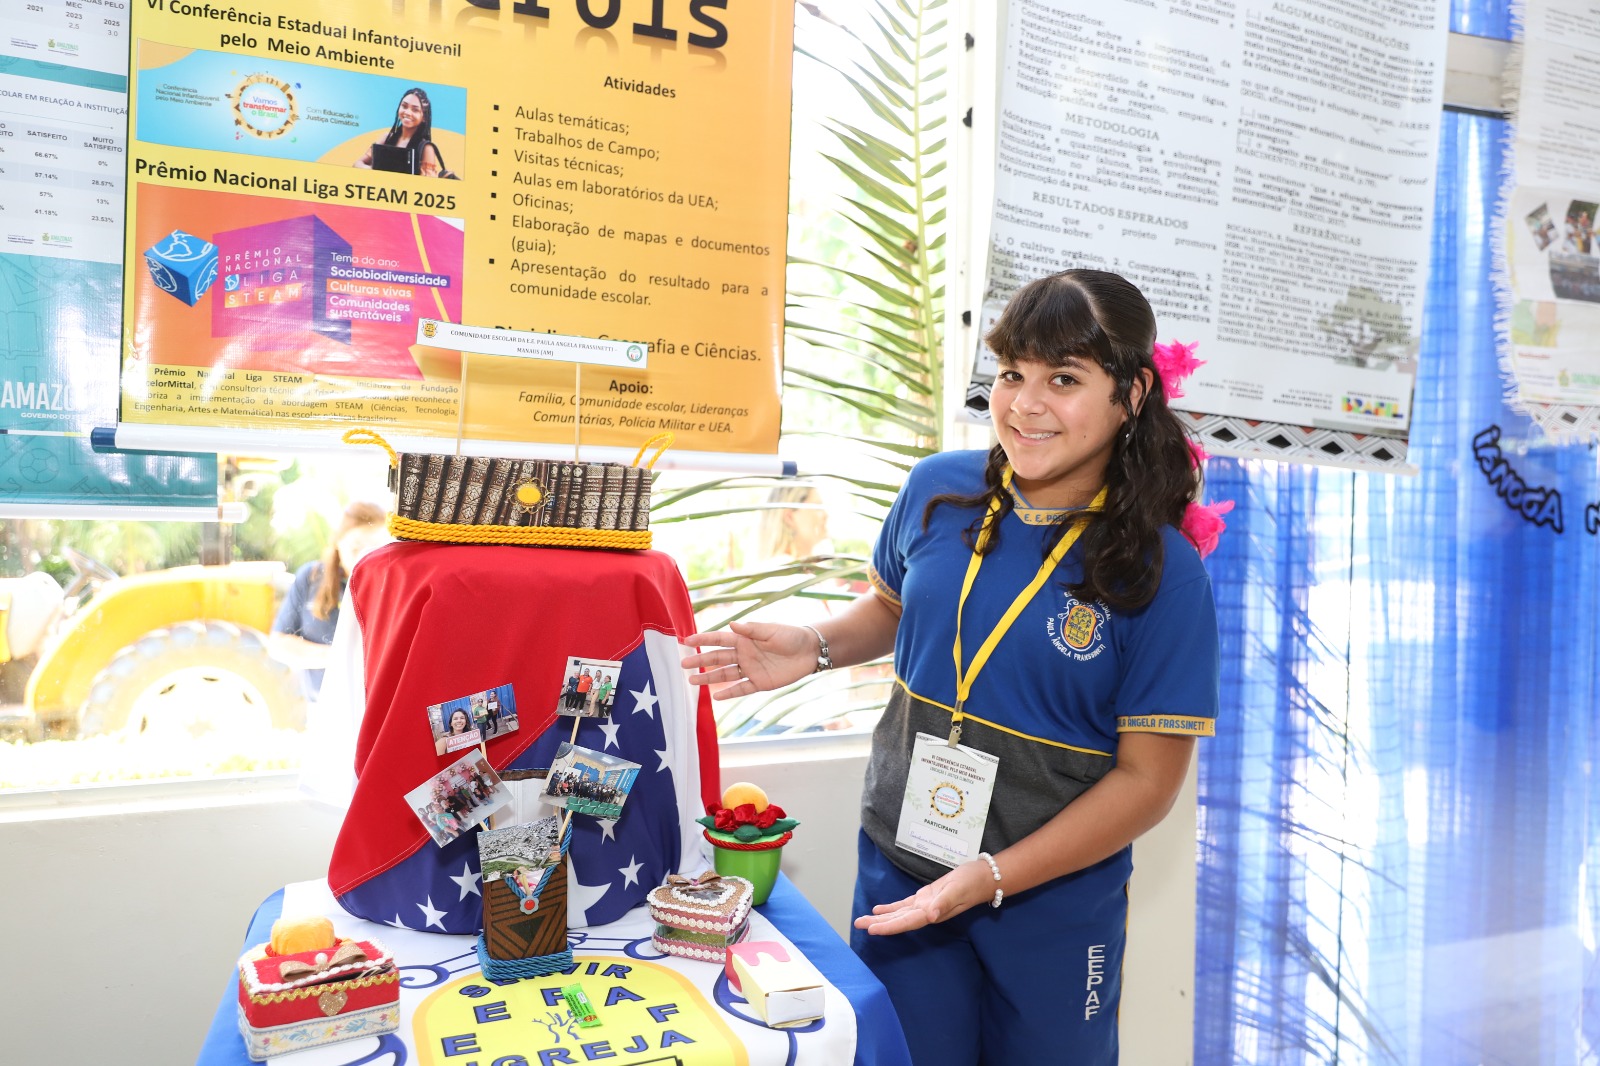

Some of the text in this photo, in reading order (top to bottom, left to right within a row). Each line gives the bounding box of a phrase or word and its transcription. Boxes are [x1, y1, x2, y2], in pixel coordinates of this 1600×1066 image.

[27, 4, 44, 12] 2021
[66, 1, 82, 9] MEC
[104, 0, 124, 9] PELO
[66, 12, 82, 20] 2023
[104, 19, 120, 27] 2025
[170, 0, 271, 27] Conferência
[278, 15, 347, 38] Estadual
[352, 28, 461, 57] Infantojuvenil
[220, 33, 395, 69] pelo Meio Ambiente
[604, 75, 676, 98] Atividades
[25, 93, 38, 101] EM
[39, 95, 75, 107] RELAÇÃO
[242, 102, 287, 113] transformar
[253, 96, 278, 105] Vamos
[323, 108, 354, 120] Educação
[330, 117, 359, 127] Climática
[515, 105, 630, 136] Aulas temáticas;
[1065, 112, 1160, 142] METODOLOGIA
[27, 130, 68, 141] SATISFEITO
[92, 136, 114, 144] MUITO
[83, 142, 122, 153] SATISFEITO
[515, 127, 660, 162] Trabalhos de Campo;
[514, 149, 624, 178] Visitas técnicas;
[135, 158, 456, 210] Prêmio Nacional Liga STEAM 2025
[513, 171, 719, 211] Aulas em laboratórios da UEA;
[513, 193, 573, 214] Oficinas;
[1032, 191, 1189, 231] RESULTADOS ESPERADOS
[512, 215, 770, 256] Elaboração de mapas e documentos
[511, 235, 557, 256] (guia);
[225, 247, 280, 263] PRÊMIO
[225, 254, 301, 272] NACIONAL
[331, 252, 400, 268] Tema do ano:
[243, 270, 298, 287] LIGA
[330, 266, 448, 286] Sociobiodiversidade
[511, 258, 769, 296] Apresentação do resultado para a
[228, 287, 299, 304] STEAM
[330, 281, 412, 298] Culturas vivas
[510, 281, 652, 306] comunidade escolar.
[329, 295, 410, 312] Comunidades
[329, 308, 402, 322] sustentáveis
[450, 330, 491, 340] COMUNIDADE
[517, 347, 540, 355] MANAUS
[681, 342, 762, 362] e Ciências.
[154, 368, 303, 384] Prêmio Liga STEAM
[220, 385, 267, 393] consultoria
[421, 384, 458, 394] Fundação
[609, 379, 653, 395] Apoio:
[411, 396, 451, 404] reconhece
[519, 390, 749, 418] Família, Comunidade escolar, Lideranças
[21, 412, 57, 420] GOVERNO
[188, 405, 210, 414] Artes
[221, 406, 273, 418] Matemática)
[335, 402, 364, 410] STEAM
[371, 403, 408, 413] (Ciências,
[415, 406, 458, 416] Tecnologia,
[533, 410, 734, 434] Comuntárias, Polícia Militar e UEA.
[1024, 514, 1032, 522] E.
[448, 731, 479, 746] ATENÇÃO
[924, 818, 958, 835] PARTICIPANTE
[1085, 944, 1106, 1020] EEPAF
